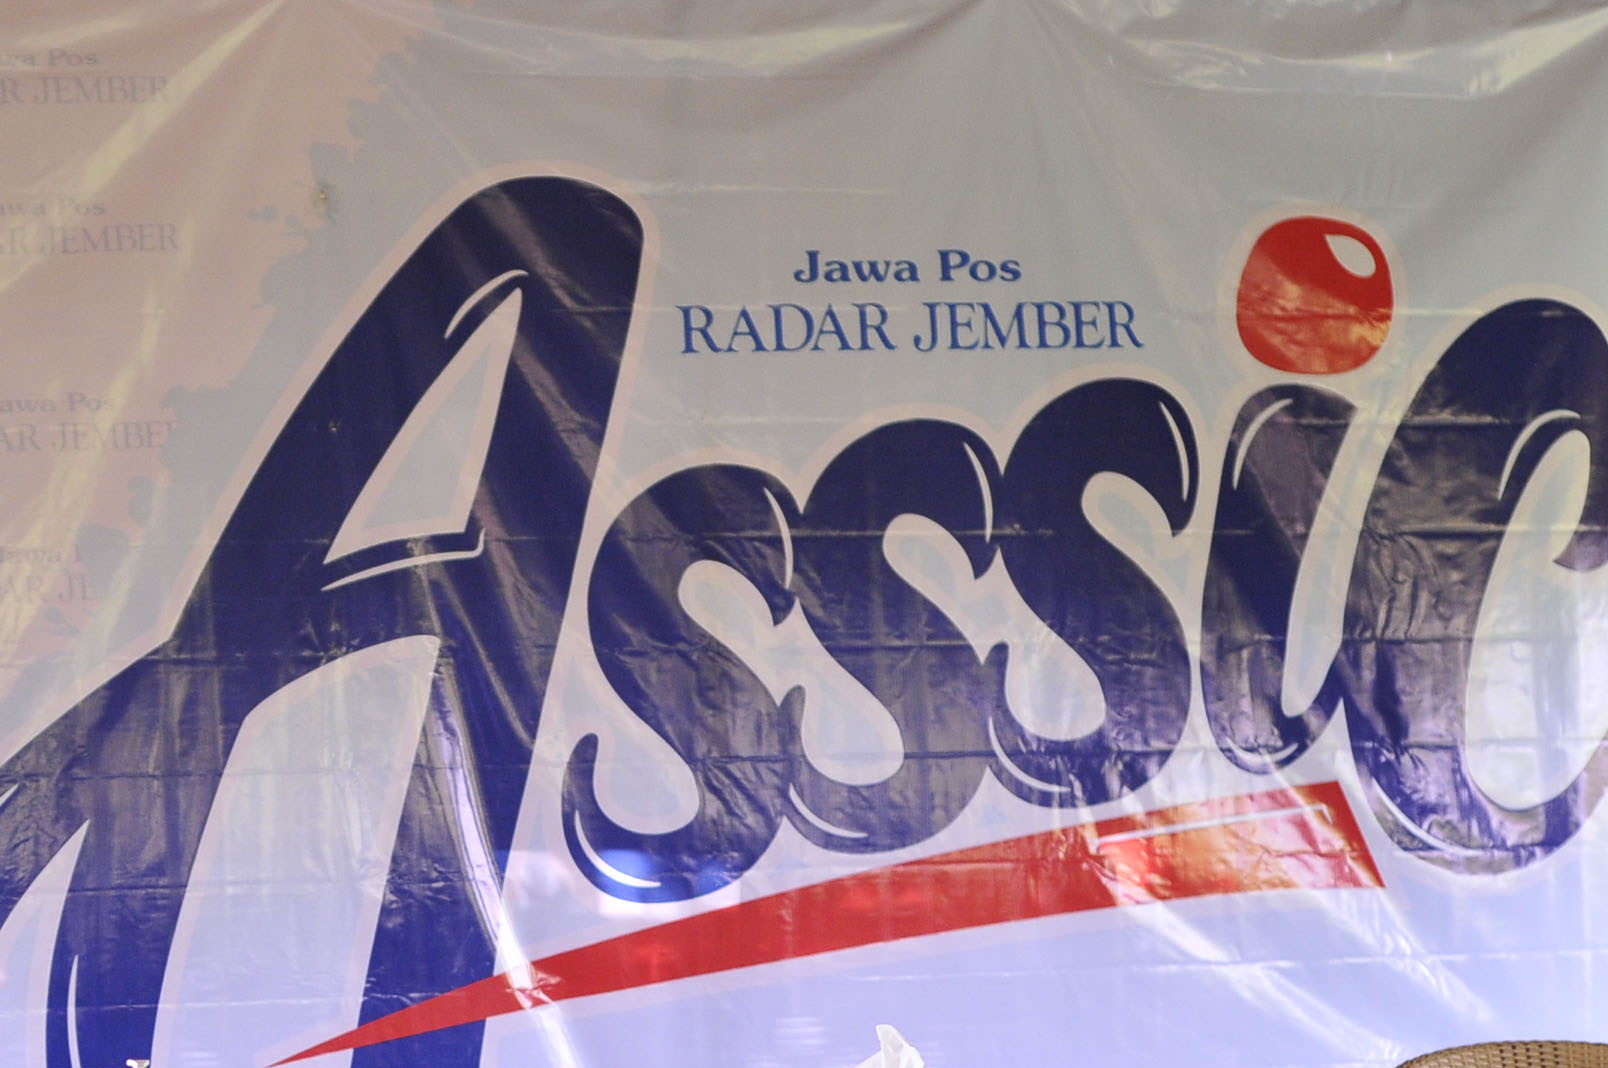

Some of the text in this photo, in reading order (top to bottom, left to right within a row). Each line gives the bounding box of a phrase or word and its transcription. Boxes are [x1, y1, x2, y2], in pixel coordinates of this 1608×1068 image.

[32, 75, 172, 105] JEMBER
[39, 224, 180, 256] JEMBER
[793, 249, 1022, 283] Jawa Pos
[676, 301, 1144, 353] RADAR JEMBER
